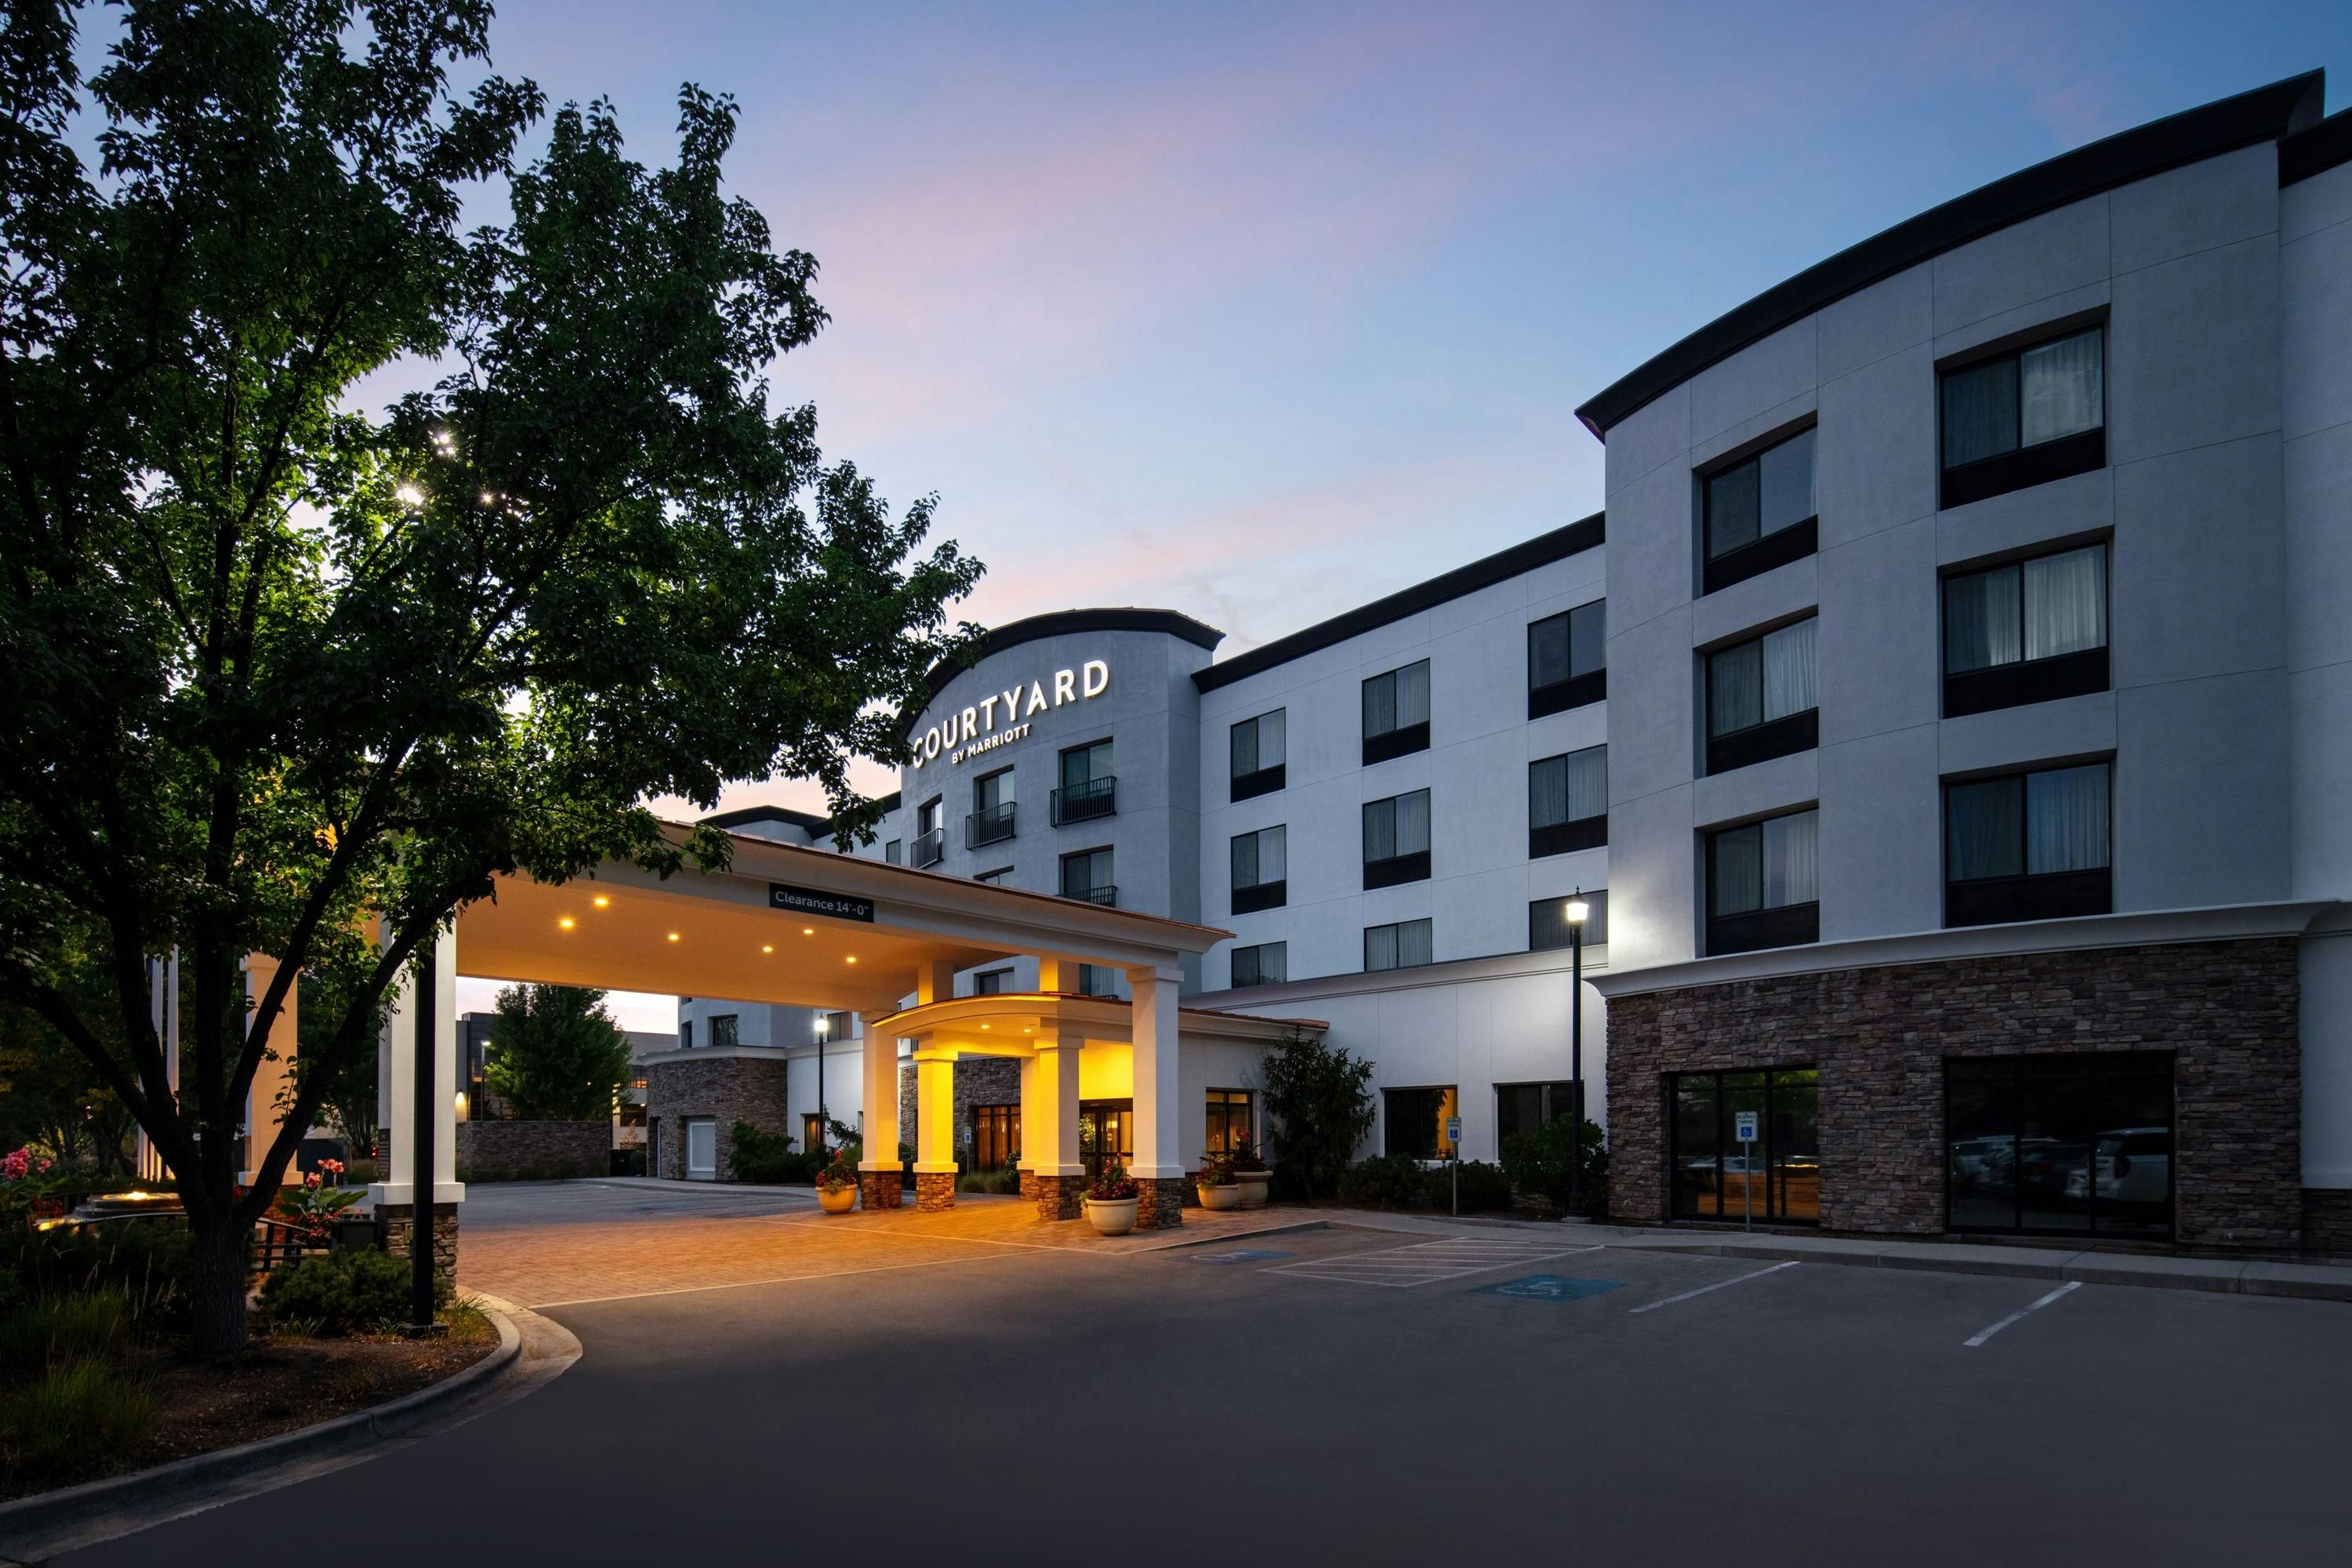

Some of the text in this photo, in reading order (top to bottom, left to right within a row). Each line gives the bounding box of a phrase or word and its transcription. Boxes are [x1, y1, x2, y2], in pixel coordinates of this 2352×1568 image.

[913, 659, 1109, 769] COURTYARD
[952, 723, 1031, 765] BY MARRIOTT
[775, 891, 834, 910] Clearance
